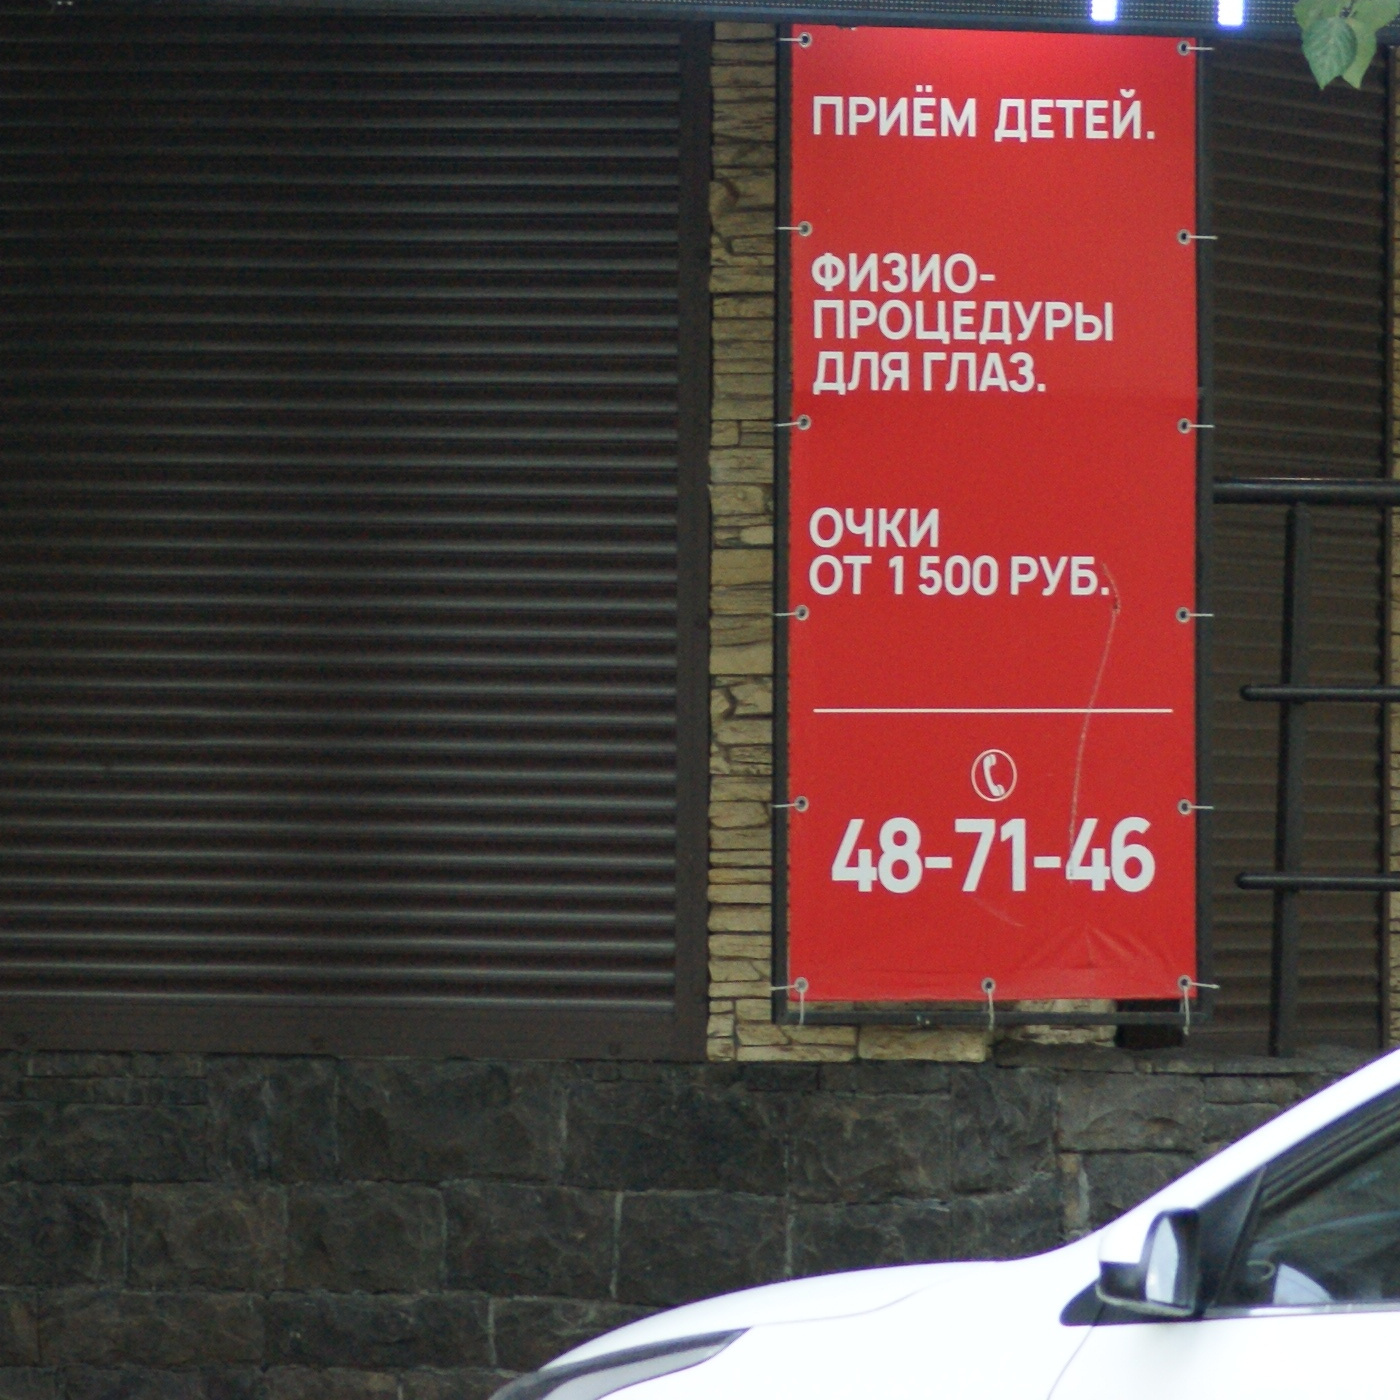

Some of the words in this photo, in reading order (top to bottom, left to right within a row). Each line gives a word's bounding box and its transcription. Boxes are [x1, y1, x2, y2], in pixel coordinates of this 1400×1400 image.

[812, 84, 977, 138] ПРИЁМ
[994, 88, 1156, 143] ДЕТЕЙ.
[811, 252, 996, 294] ФИЗИО-
[812, 299, 1114, 345] ПРОЦЕДУРЫ
[812, 350, 910, 395] ДЛЯ
[922, 351, 1047, 393] ГЛАЗ.
[809, 506, 940, 549] ОЧКИ
[808, 554, 873, 596] ОТ
[1010, 555, 1110, 597] РУБ.
[831, 816, 1156, 894] 48-71-46
